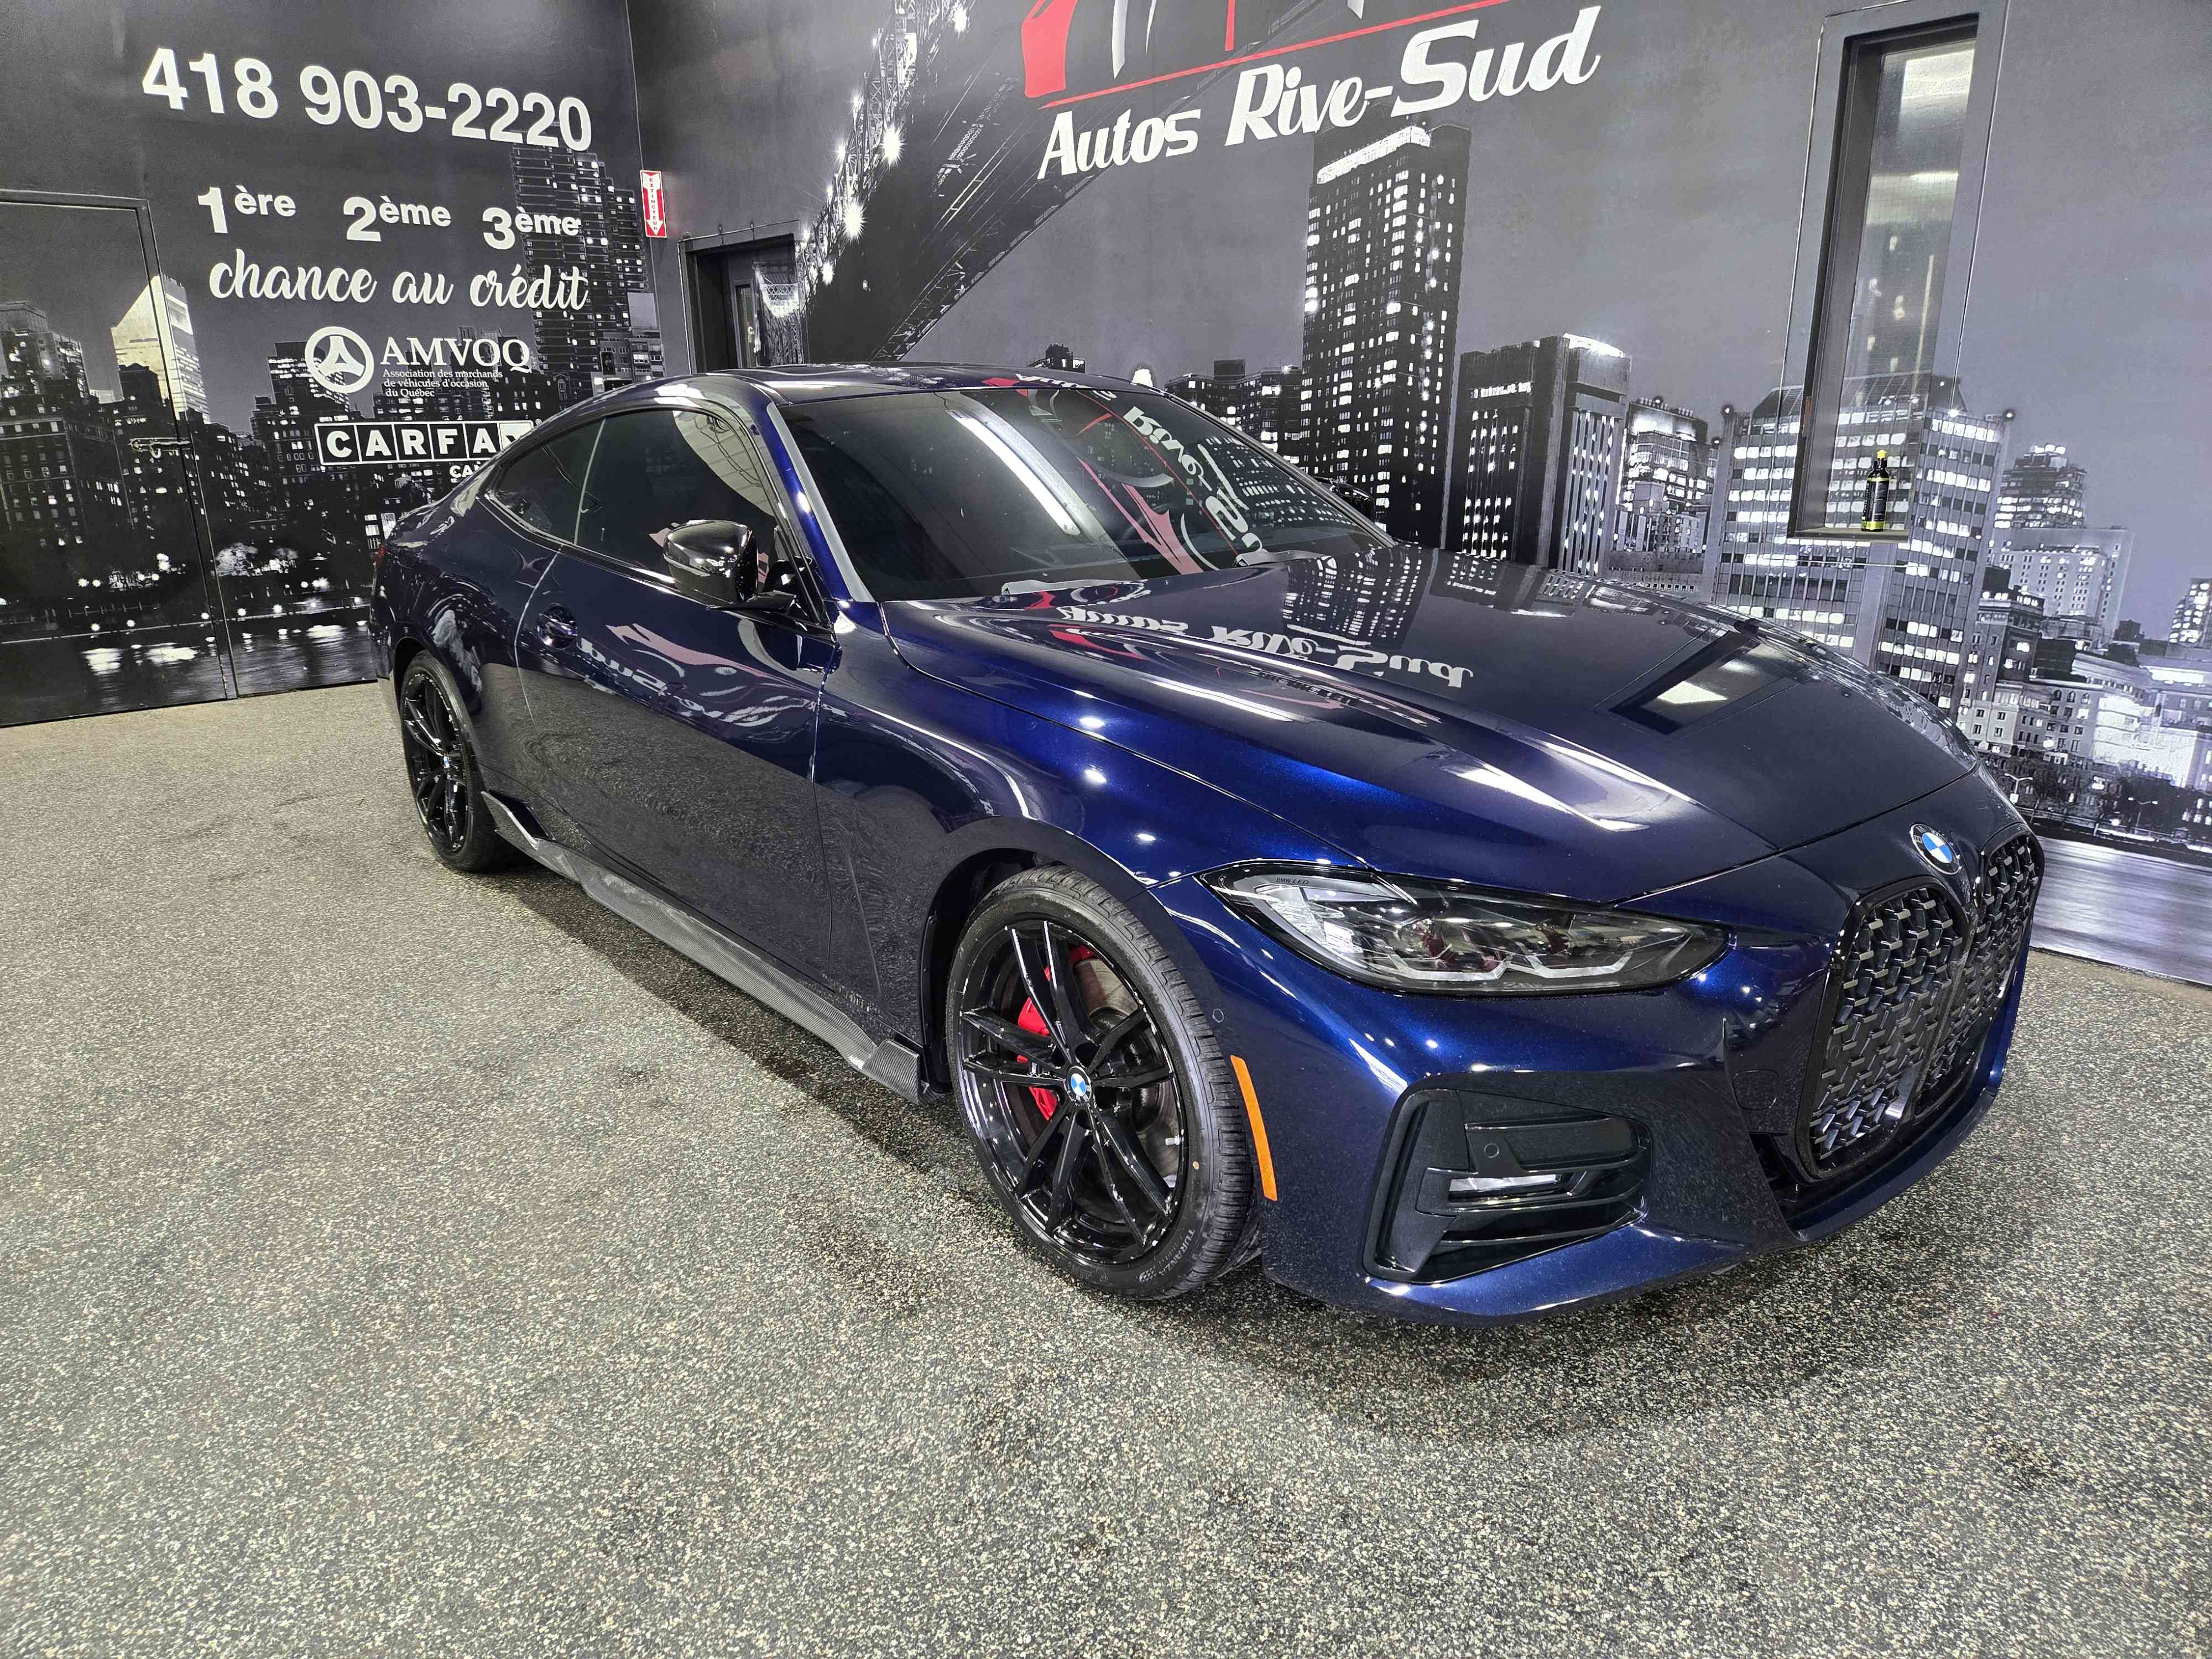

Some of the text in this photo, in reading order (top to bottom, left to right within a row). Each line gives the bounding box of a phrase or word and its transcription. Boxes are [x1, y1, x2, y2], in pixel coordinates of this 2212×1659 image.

[142, 47, 592, 152] 418 903-2220
[1037, 6, 1601, 180] Autos Rive-Sud
[197, 185, 582, 250] 1ère 2ème 3ème
[649, 178, 658, 231] EXTINCTEUR
[209, 248, 589, 310] chance au crédit
[380, 337, 531, 374] AMVOQ
[382, 368, 503, 378] Association des marchands
[384, 378, 488, 388] de véhicules d'occasion
[385, 388, 435, 398] du Québec
[1159, 1229, 1196, 1276] TURANZA
